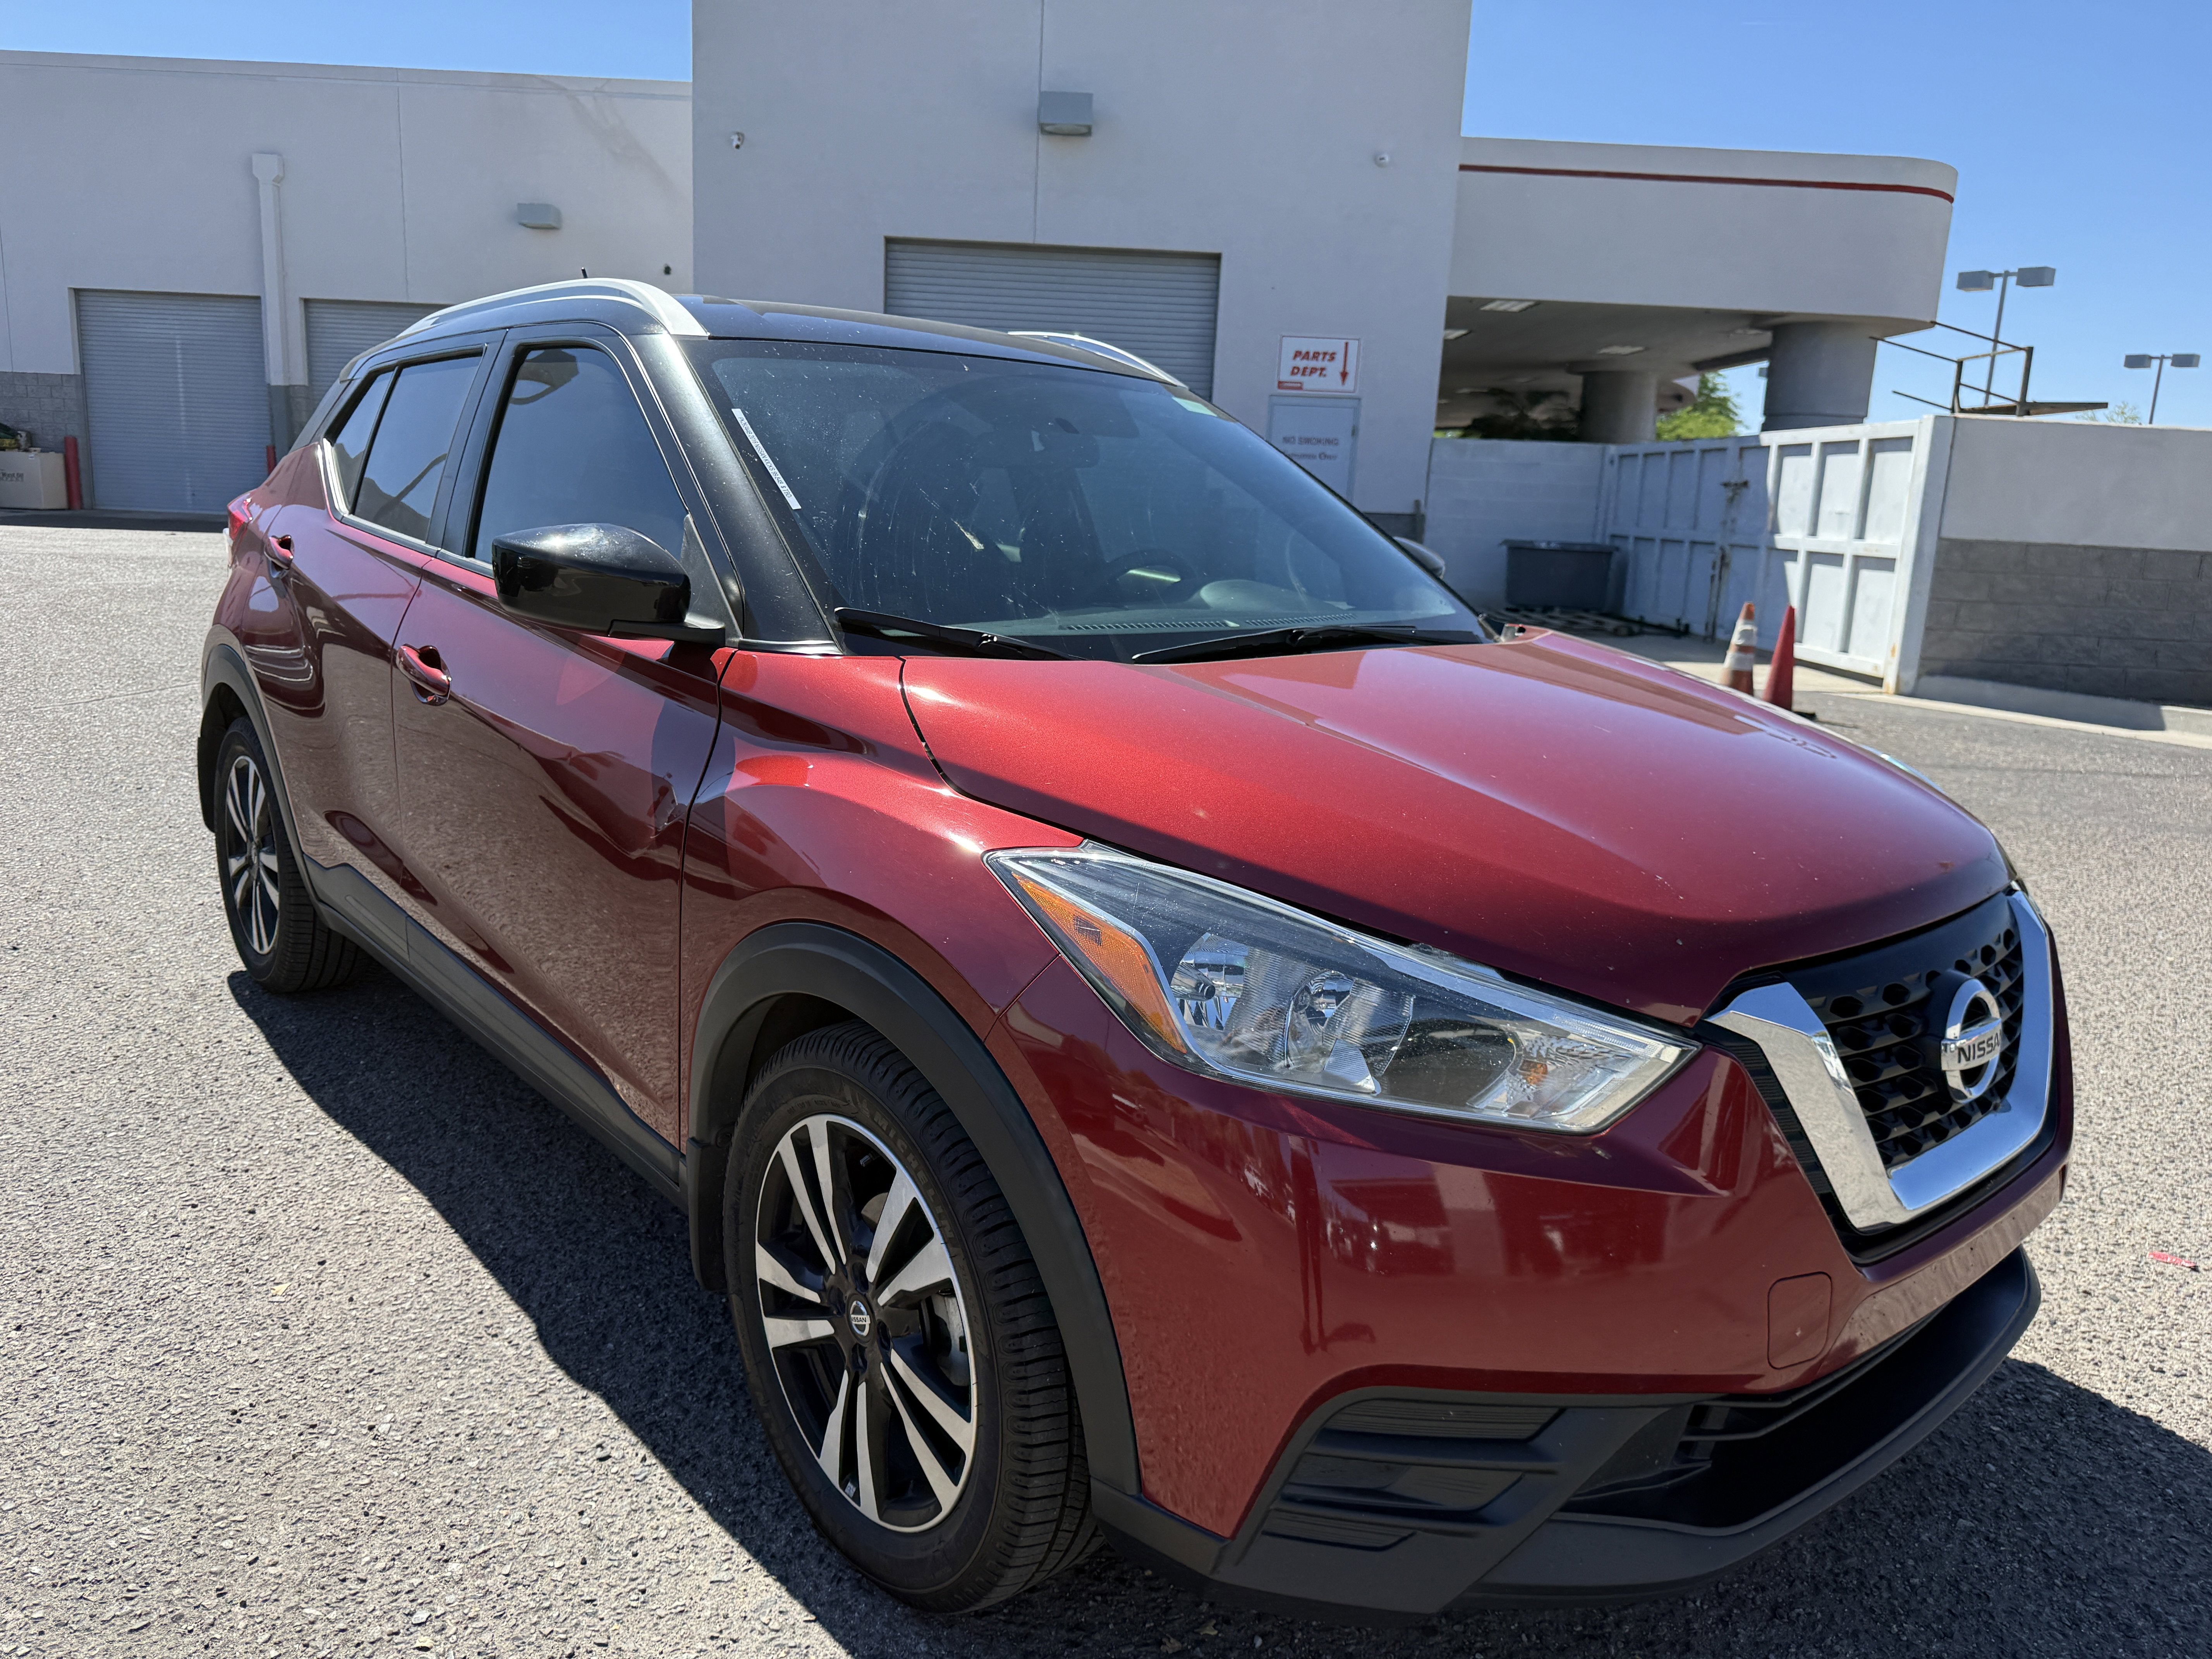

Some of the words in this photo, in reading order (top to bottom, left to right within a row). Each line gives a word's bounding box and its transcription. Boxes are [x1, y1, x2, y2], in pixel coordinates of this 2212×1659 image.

[1293, 350, 1337, 362] PARTS
[1290, 366, 1327, 378] DEPT.
[1283, 436, 1296, 444] NO
[1297, 436, 1339, 446] SMOKING
[753, 444, 767, 459] NISSAN
[764, 459, 775, 471] KICKS
[783, 489, 792, 498] TBD
[873, 1111, 954, 1238] MICHELIN
